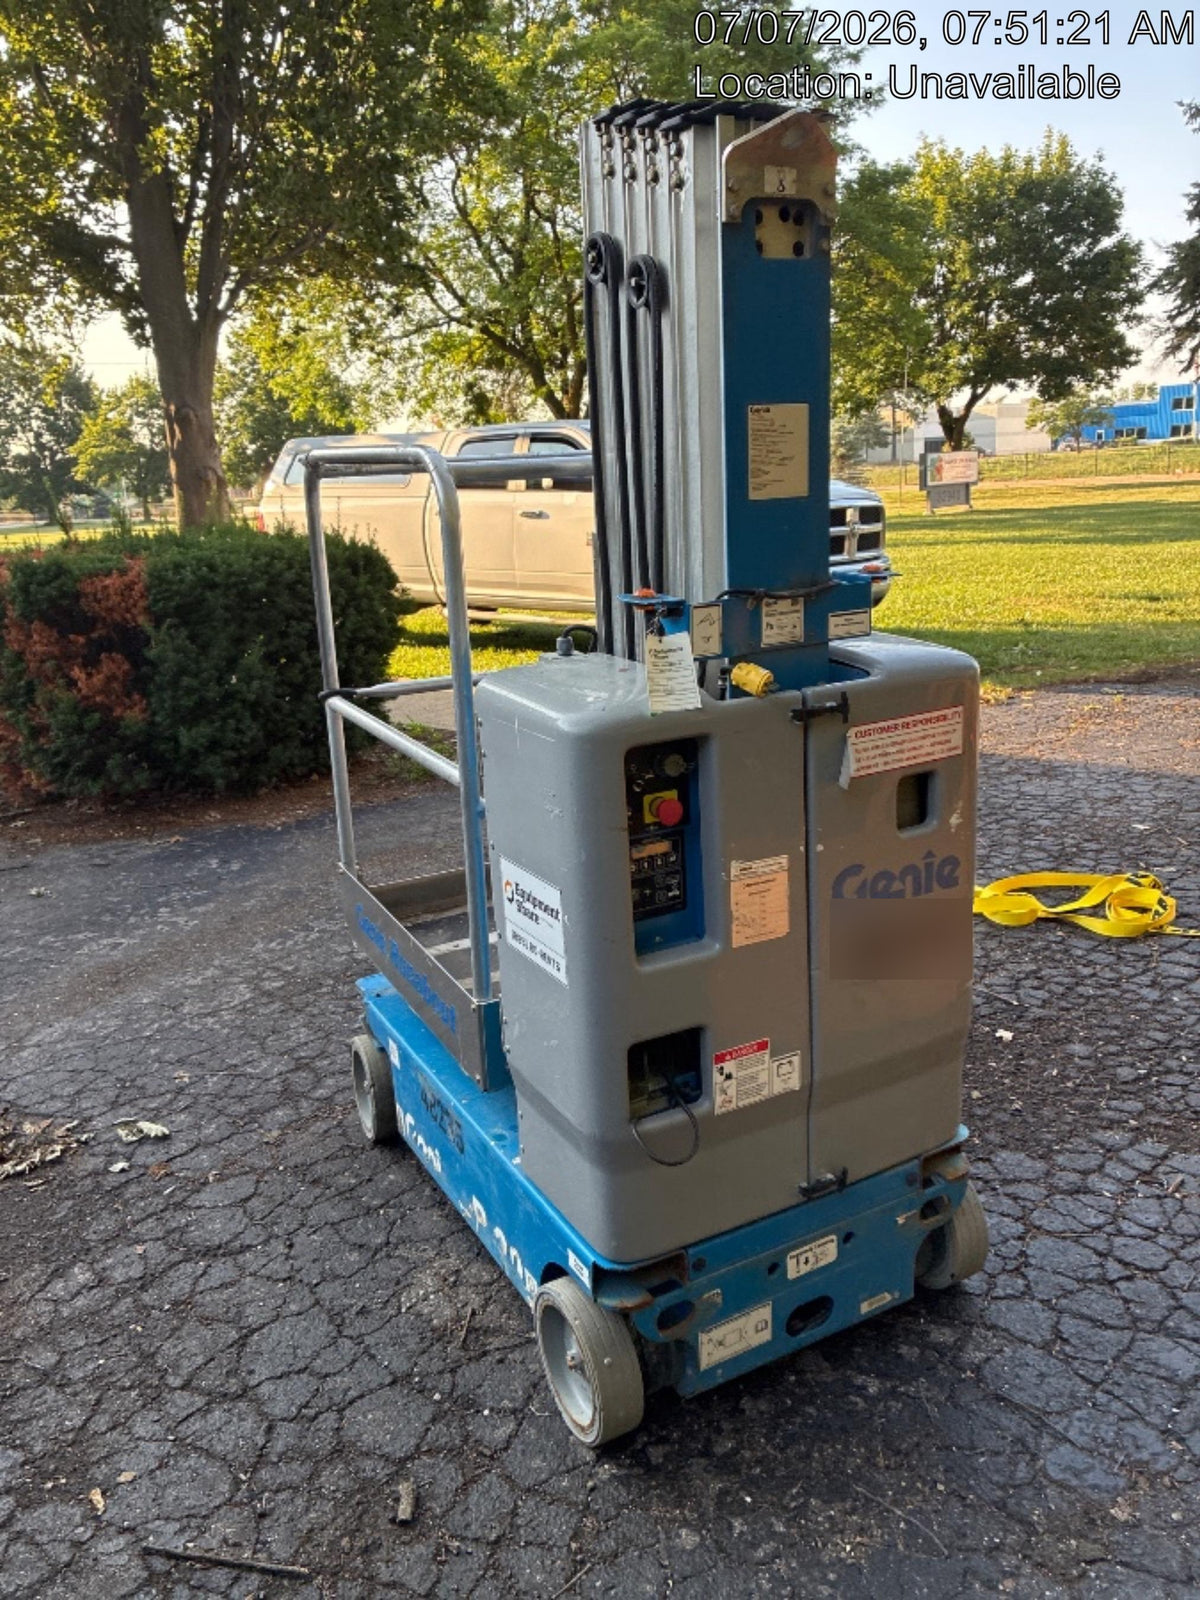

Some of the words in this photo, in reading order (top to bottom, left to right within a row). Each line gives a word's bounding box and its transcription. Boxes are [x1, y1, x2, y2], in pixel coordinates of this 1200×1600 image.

[855, 723, 900, 740] CUSTOMER
[901, 710, 961, 731] RESPONSIBILITY
[832, 850, 961, 899] Genie
[515, 882, 560, 922] Equipment
